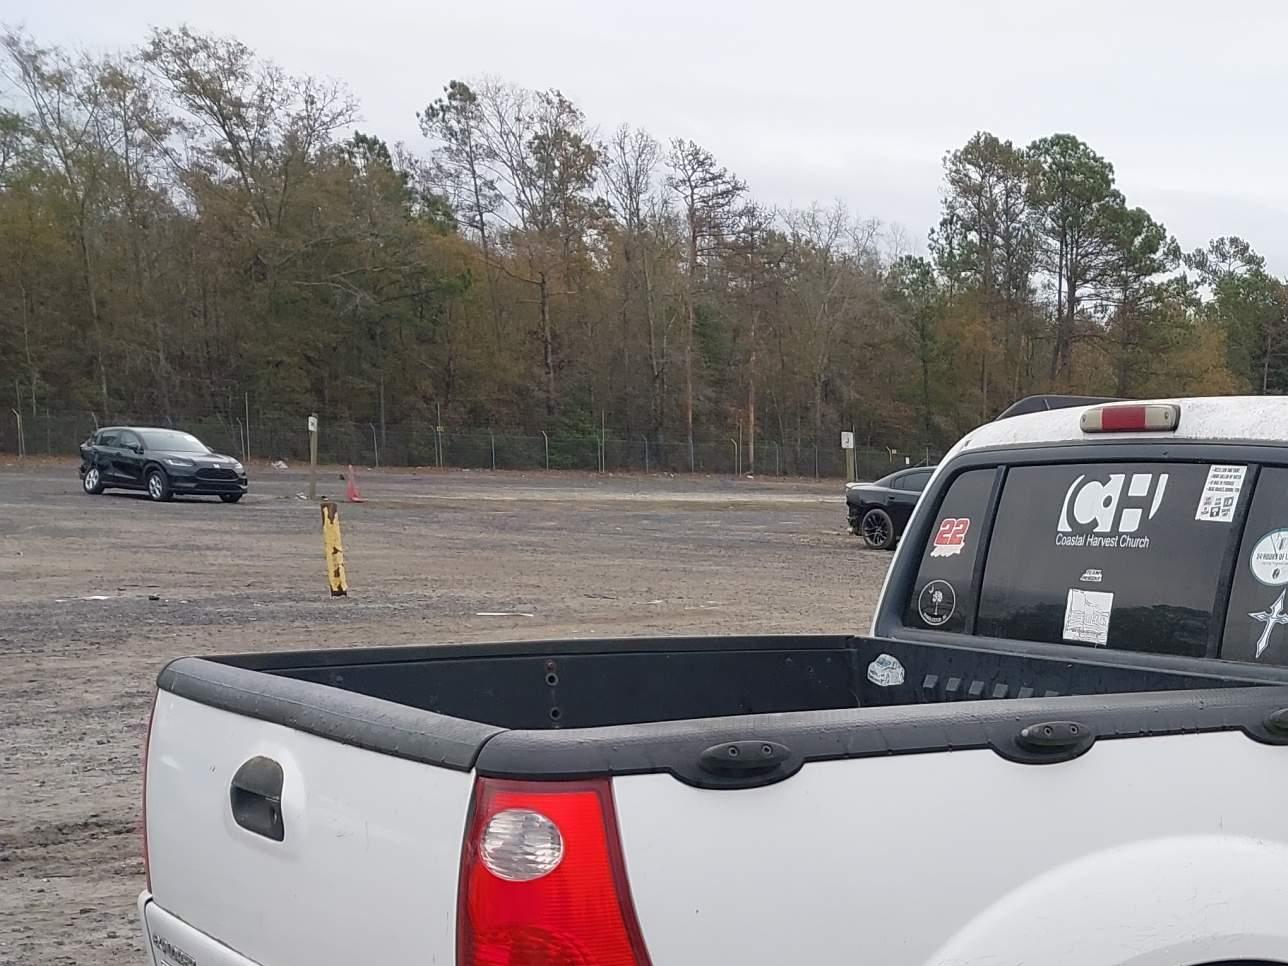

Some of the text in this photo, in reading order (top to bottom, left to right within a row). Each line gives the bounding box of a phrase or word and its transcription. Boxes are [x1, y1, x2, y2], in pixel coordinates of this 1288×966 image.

[933, 518, 970, 547] 22
[1055, 533, 1150, 548] Coastal Harvest Church
